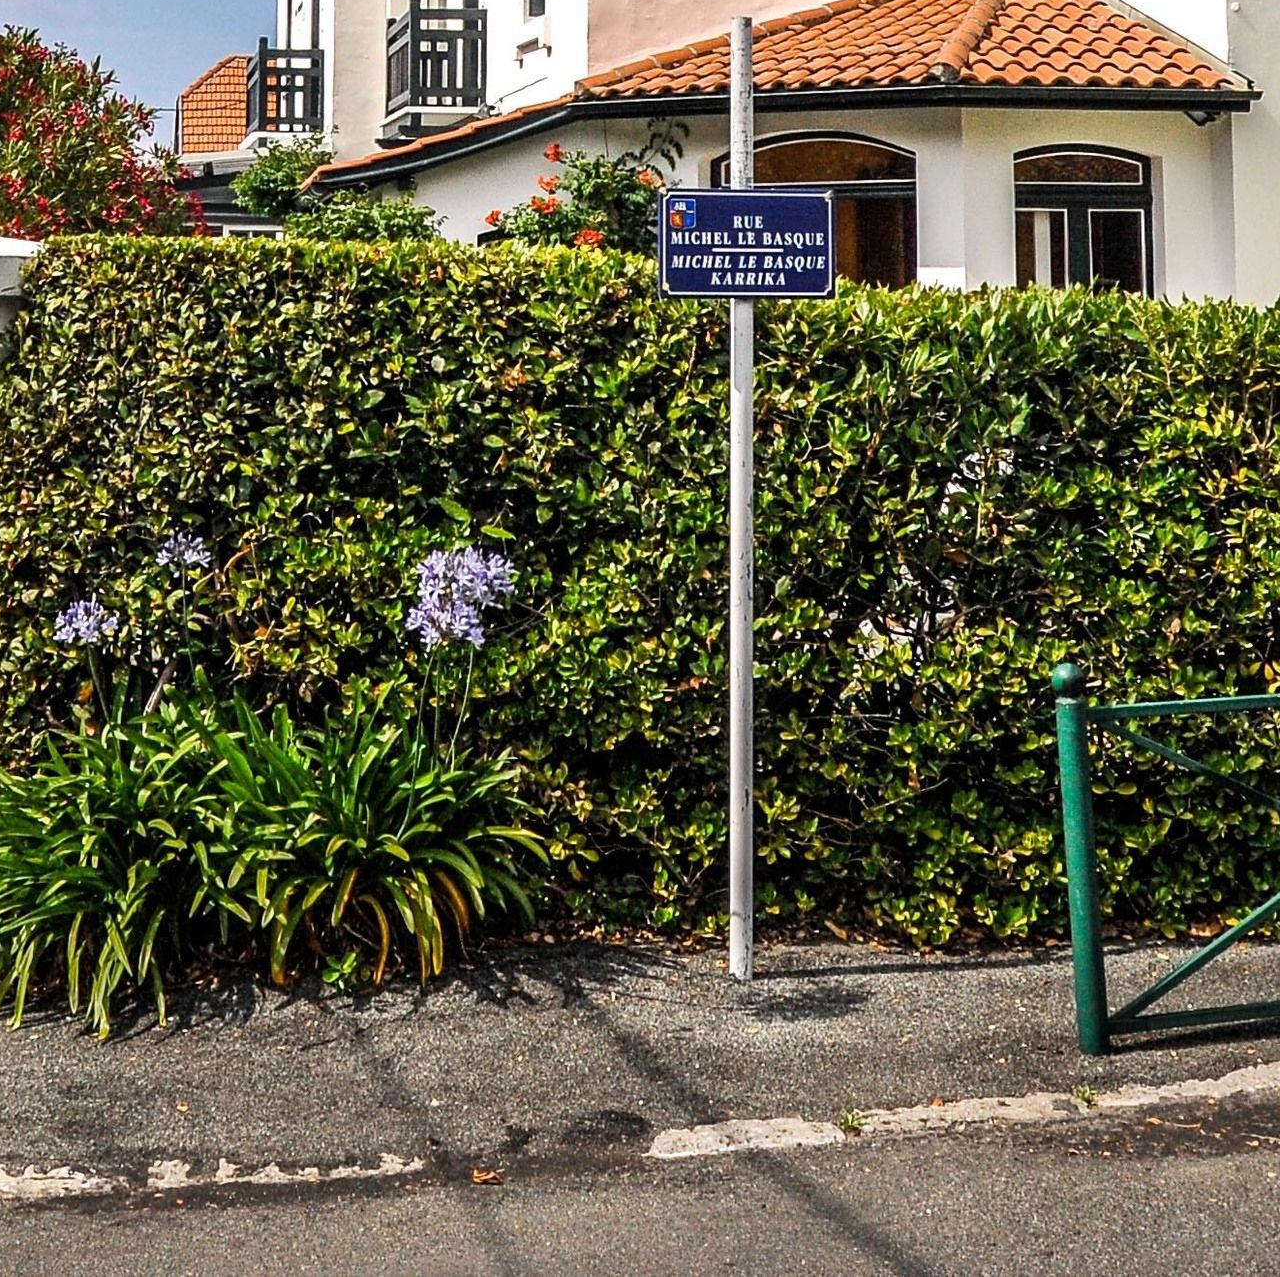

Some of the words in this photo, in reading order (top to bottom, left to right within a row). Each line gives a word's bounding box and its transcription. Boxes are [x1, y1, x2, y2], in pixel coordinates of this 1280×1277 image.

[733, 215, 764, 229] RUE
[670, 231, 732, 246] MICHEL
[738, 232, 756, 246] LE
[763, 232, 825, 249] BASQUE
[671, 255, 732, 269] MICHEL
[738, 255, 757, 269] LE
[763, 255, 826, 272] BASQUE
[710, 272, 786, 286] KARRIKA
